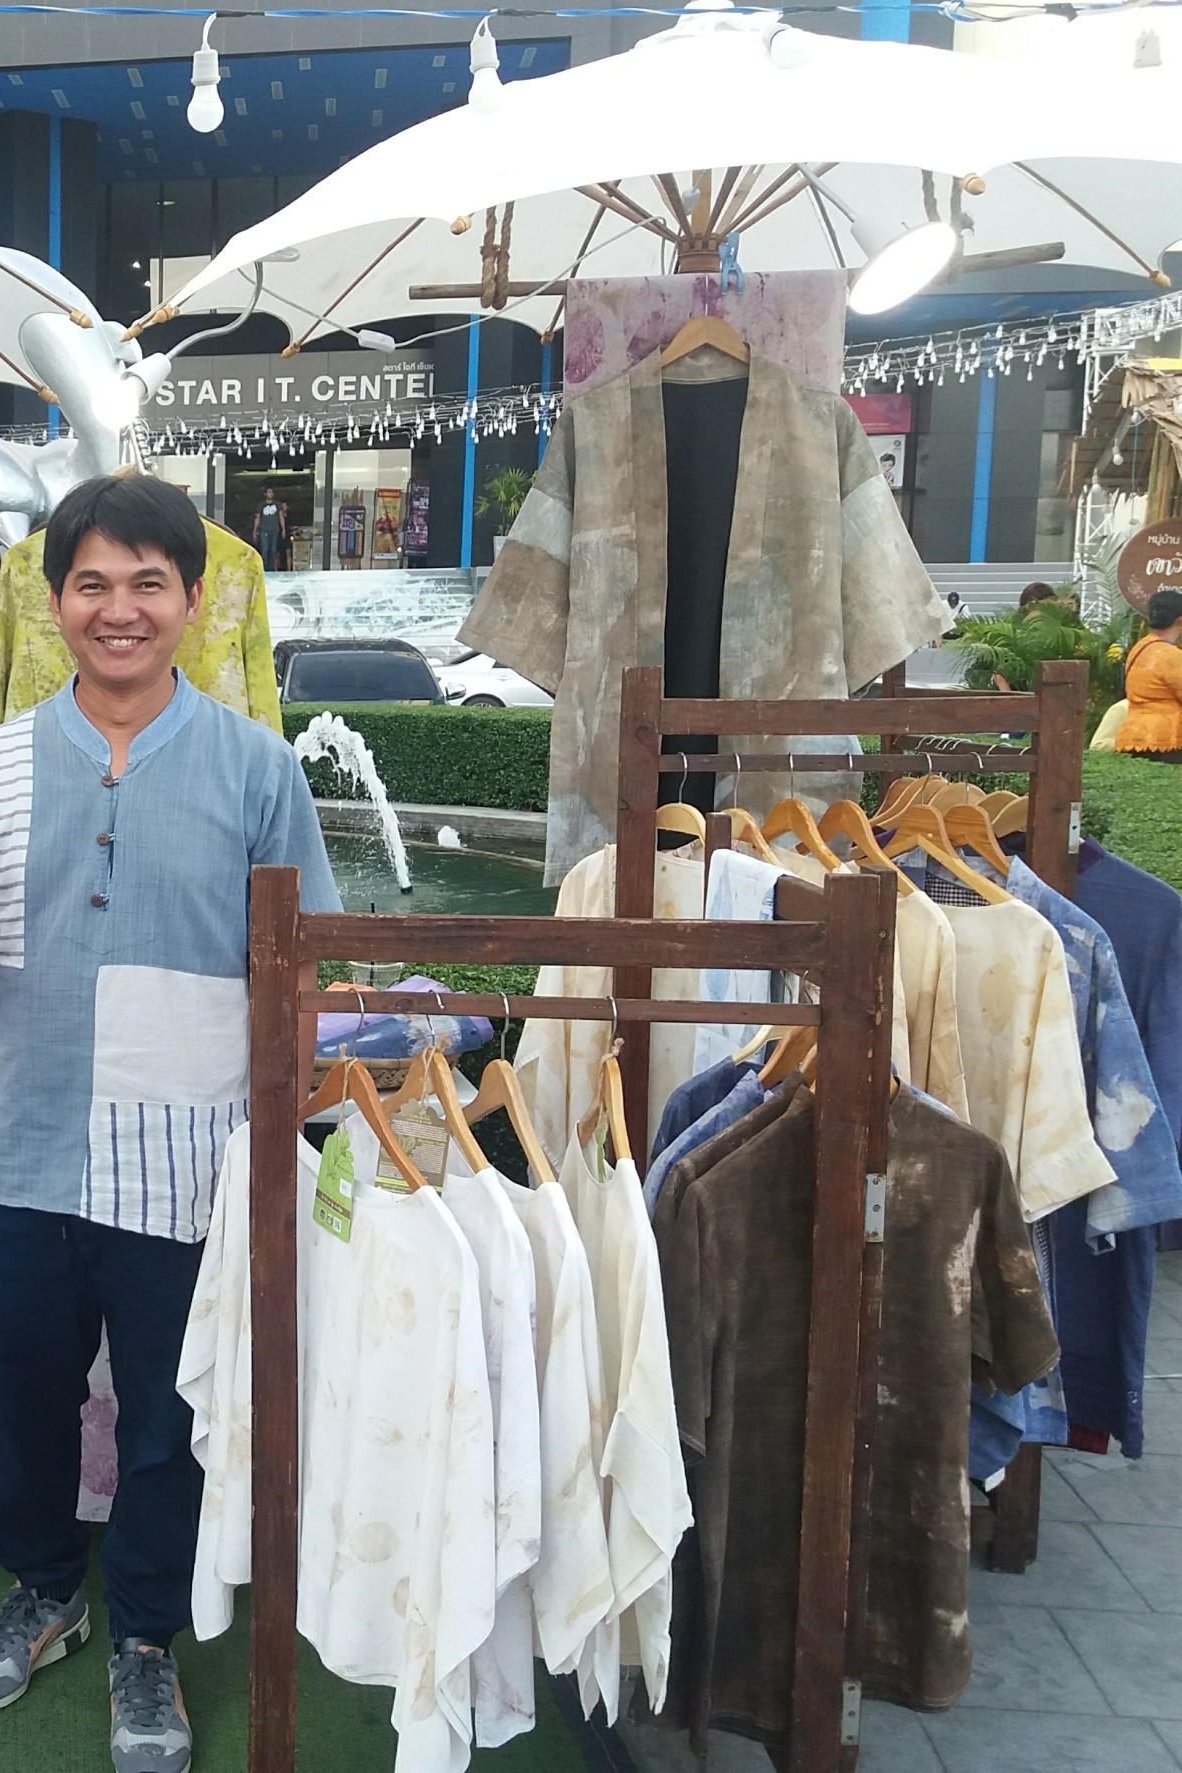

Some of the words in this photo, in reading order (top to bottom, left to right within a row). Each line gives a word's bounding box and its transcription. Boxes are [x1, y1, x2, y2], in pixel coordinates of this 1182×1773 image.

[156, 379, 242, 406] STAR
[1147, 533, 1180, 546] หมู่บ้าน
